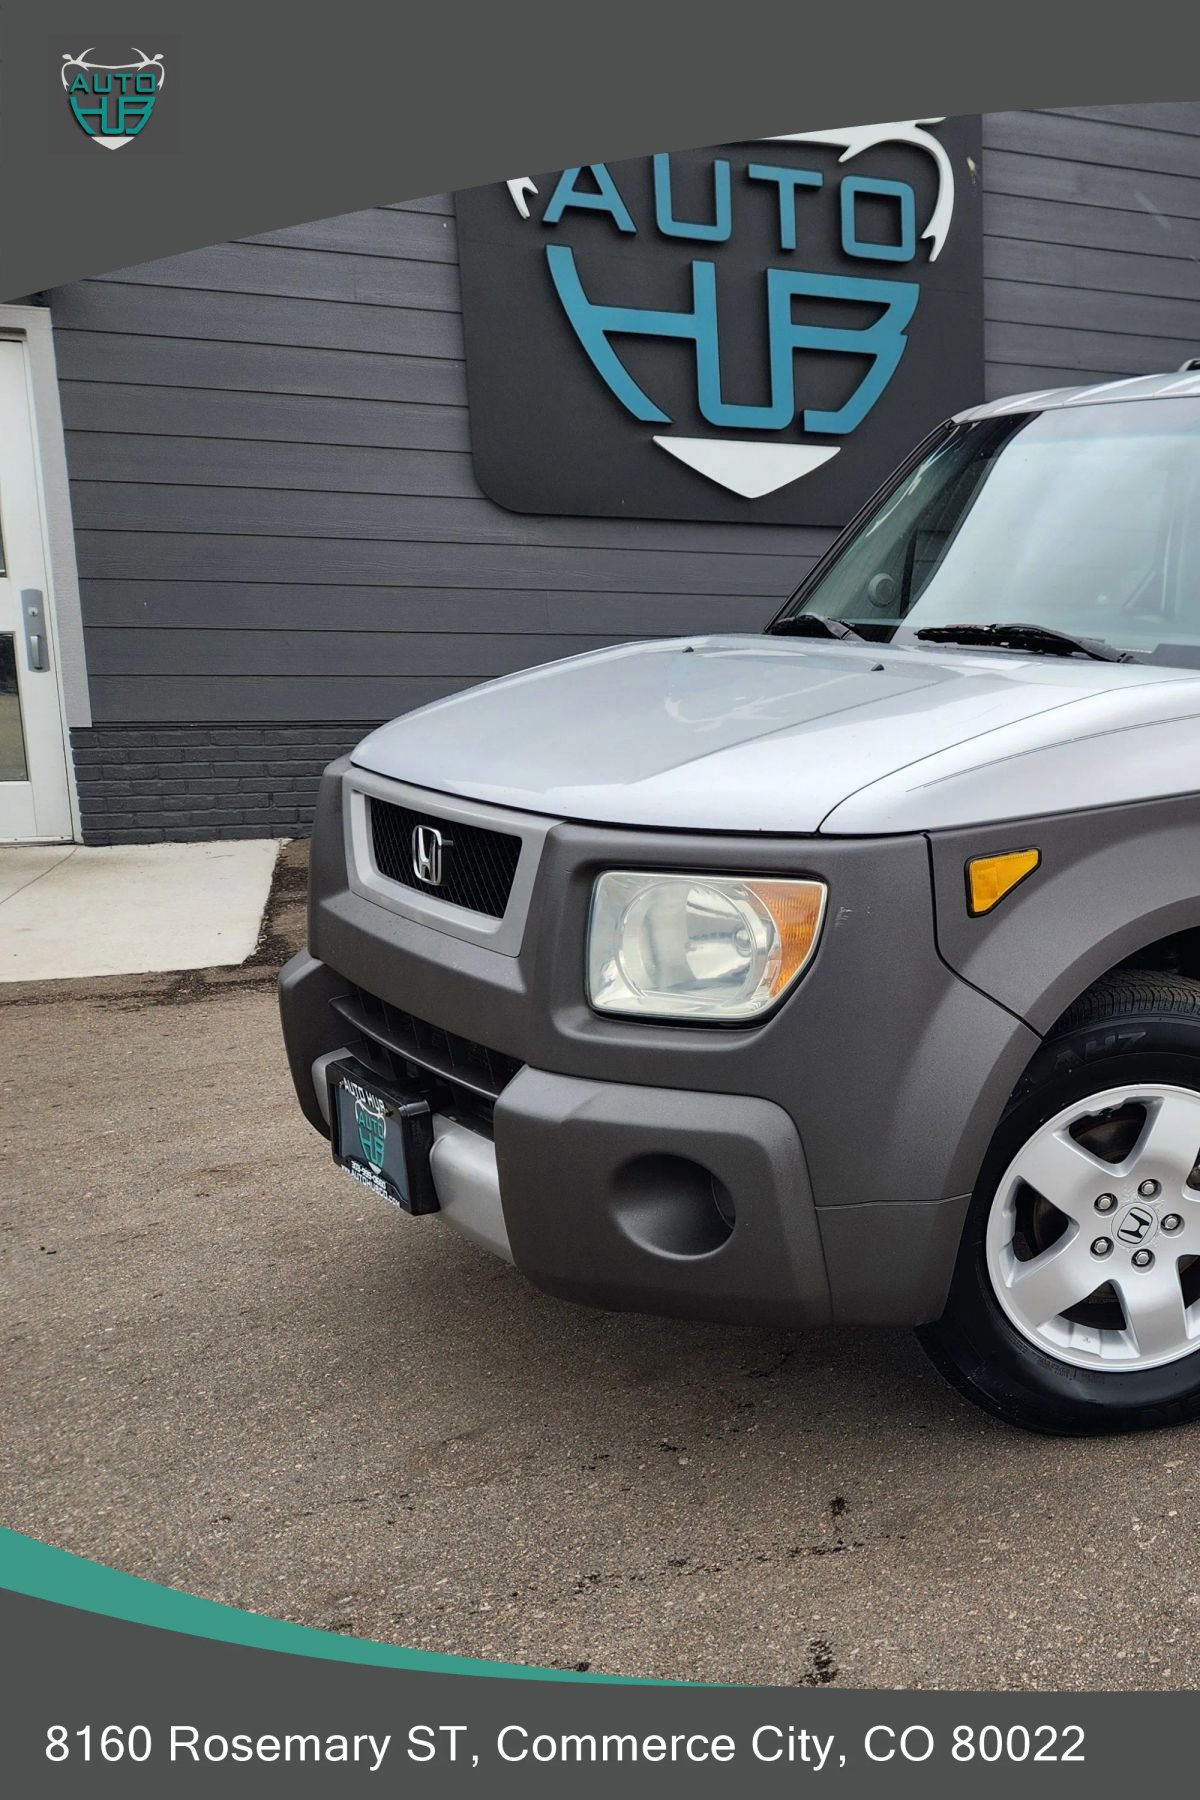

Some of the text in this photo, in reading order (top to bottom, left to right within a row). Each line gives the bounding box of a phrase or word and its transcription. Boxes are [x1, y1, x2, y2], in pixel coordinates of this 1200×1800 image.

[542, 152, 917, 263] AUTO
[545, 243, 921, 435] HUB
[343, 1077, 366, 1103] AUTO
[359, 1111, 384, 1139] AUTO
